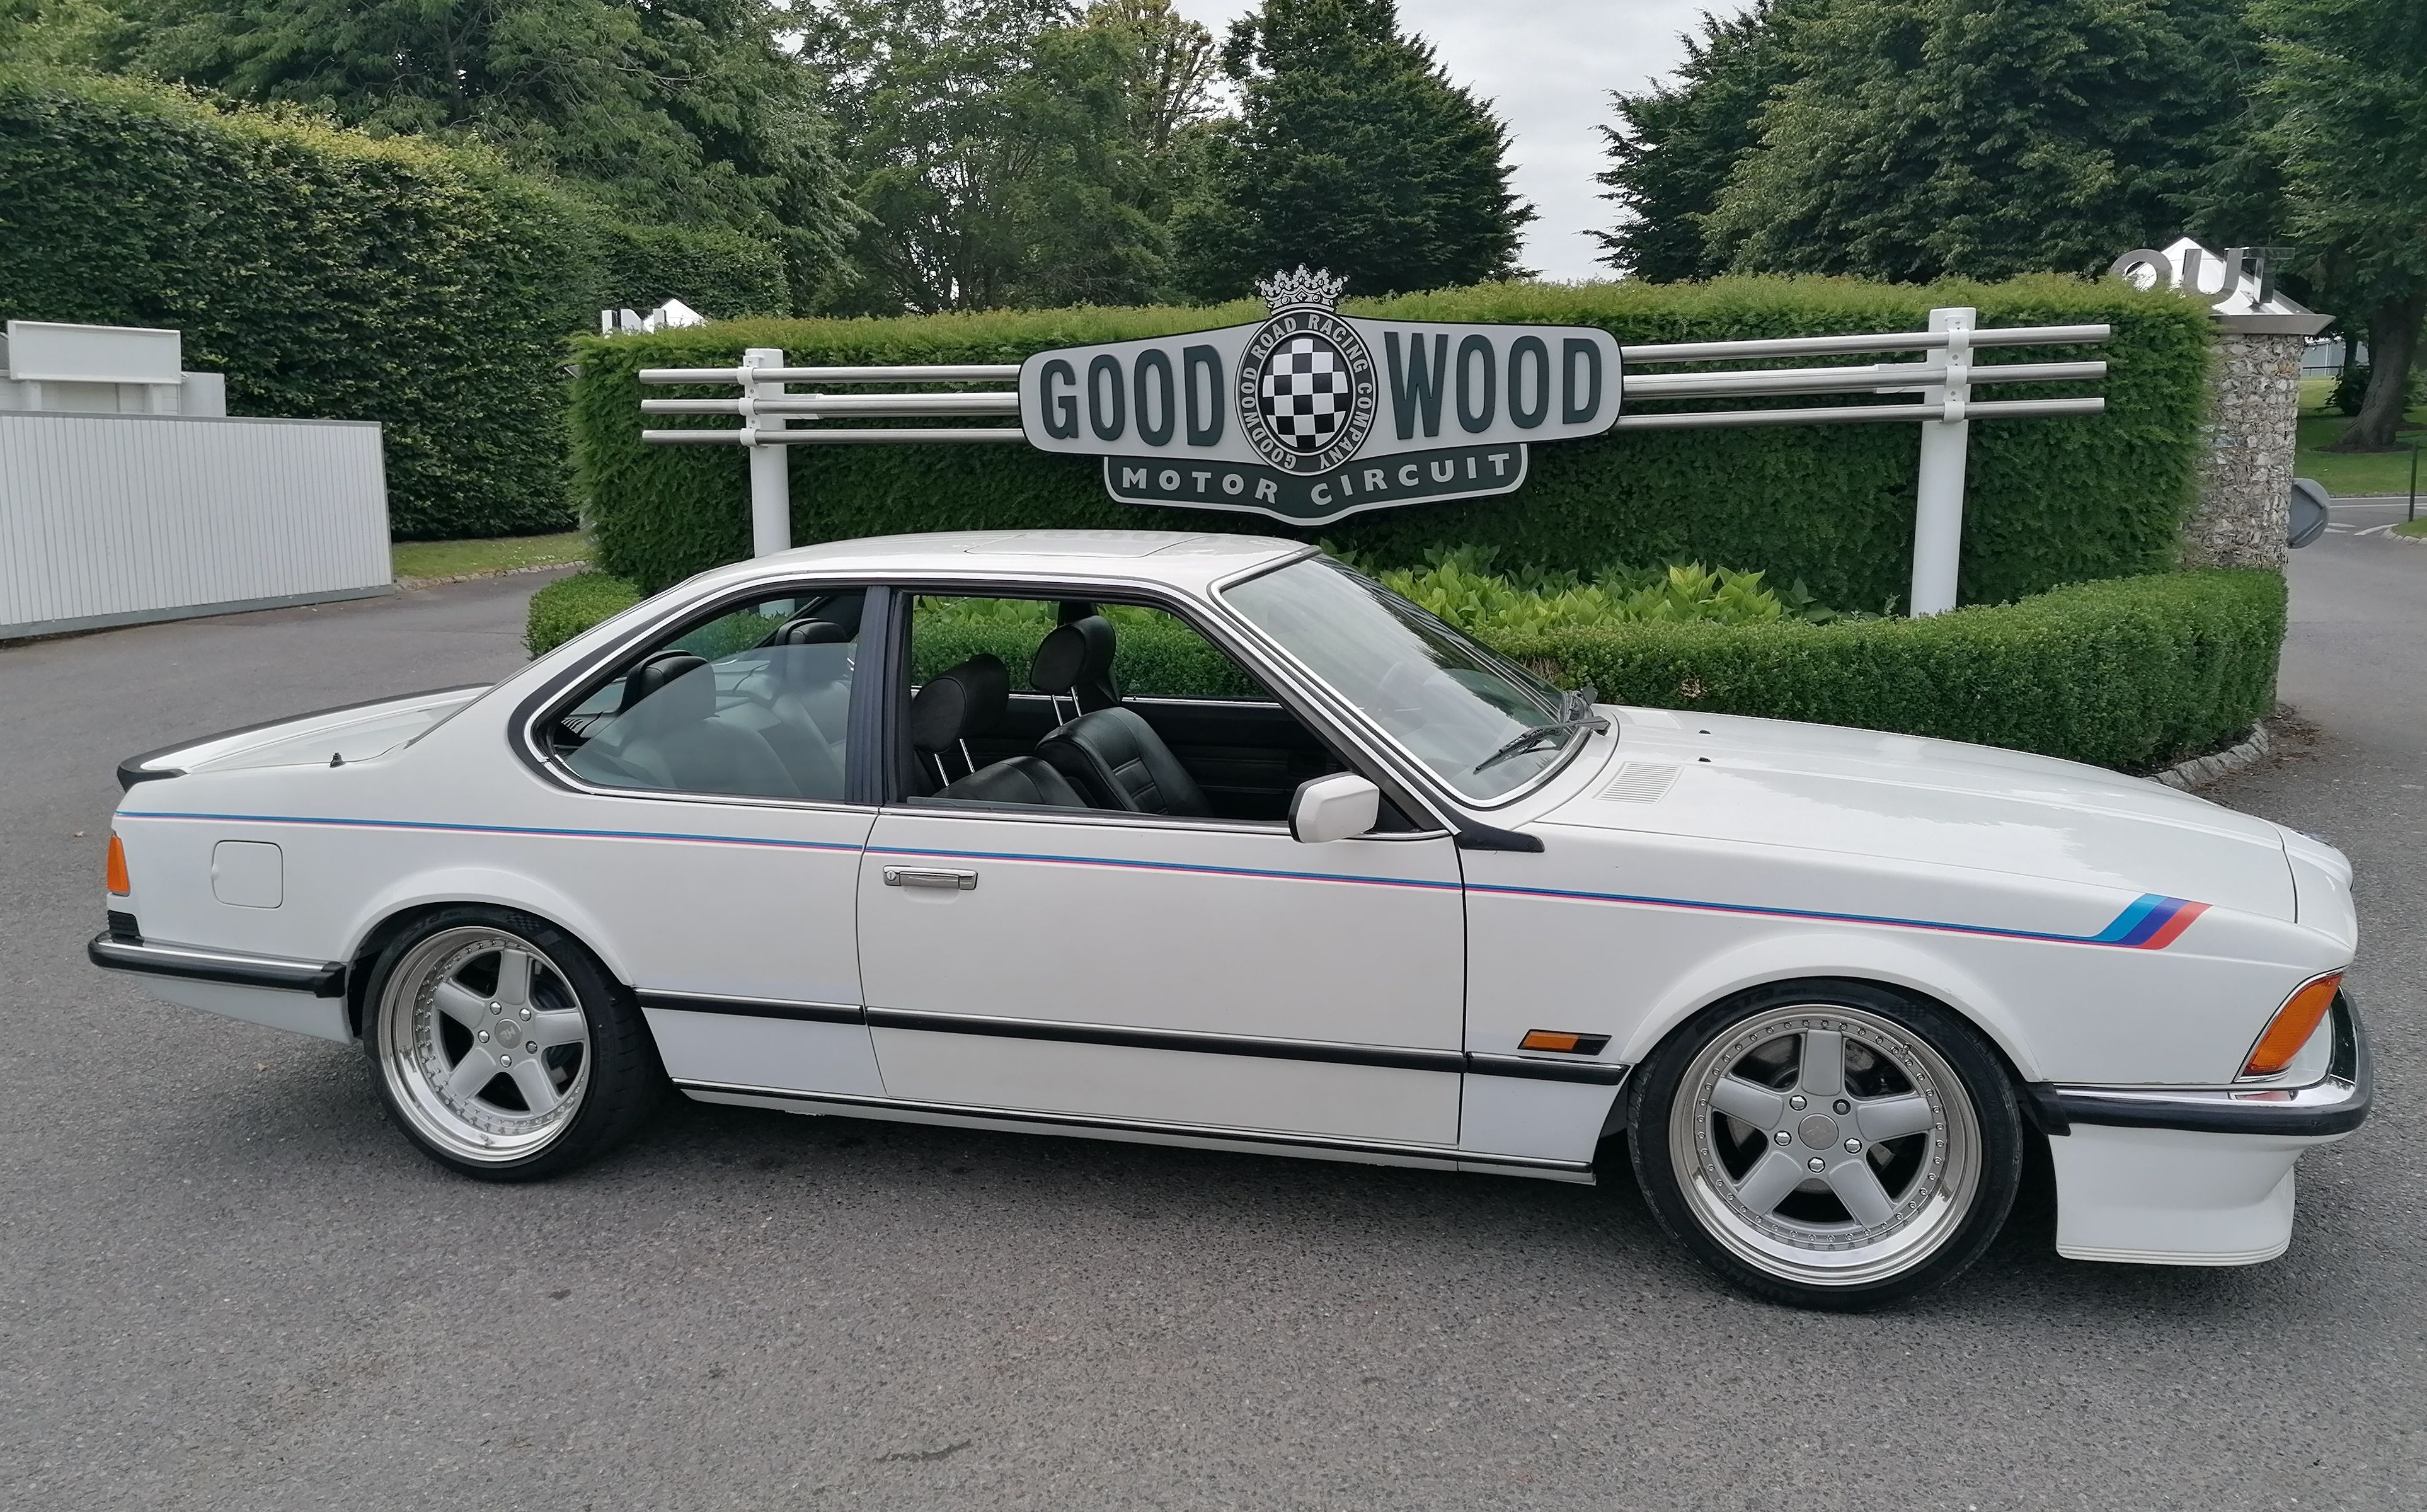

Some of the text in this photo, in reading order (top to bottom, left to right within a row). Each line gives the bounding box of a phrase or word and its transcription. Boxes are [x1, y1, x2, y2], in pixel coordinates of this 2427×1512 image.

[2110, 247, 2295, 306] OUT
[1040, 331, 1602, 446] GOOD WOOD
[1241, 314, 1372, 469] GOODWOOD ROAD RACING COMPANY
[1122, 453, 1510, 505] MOTOR CIRCUIT
